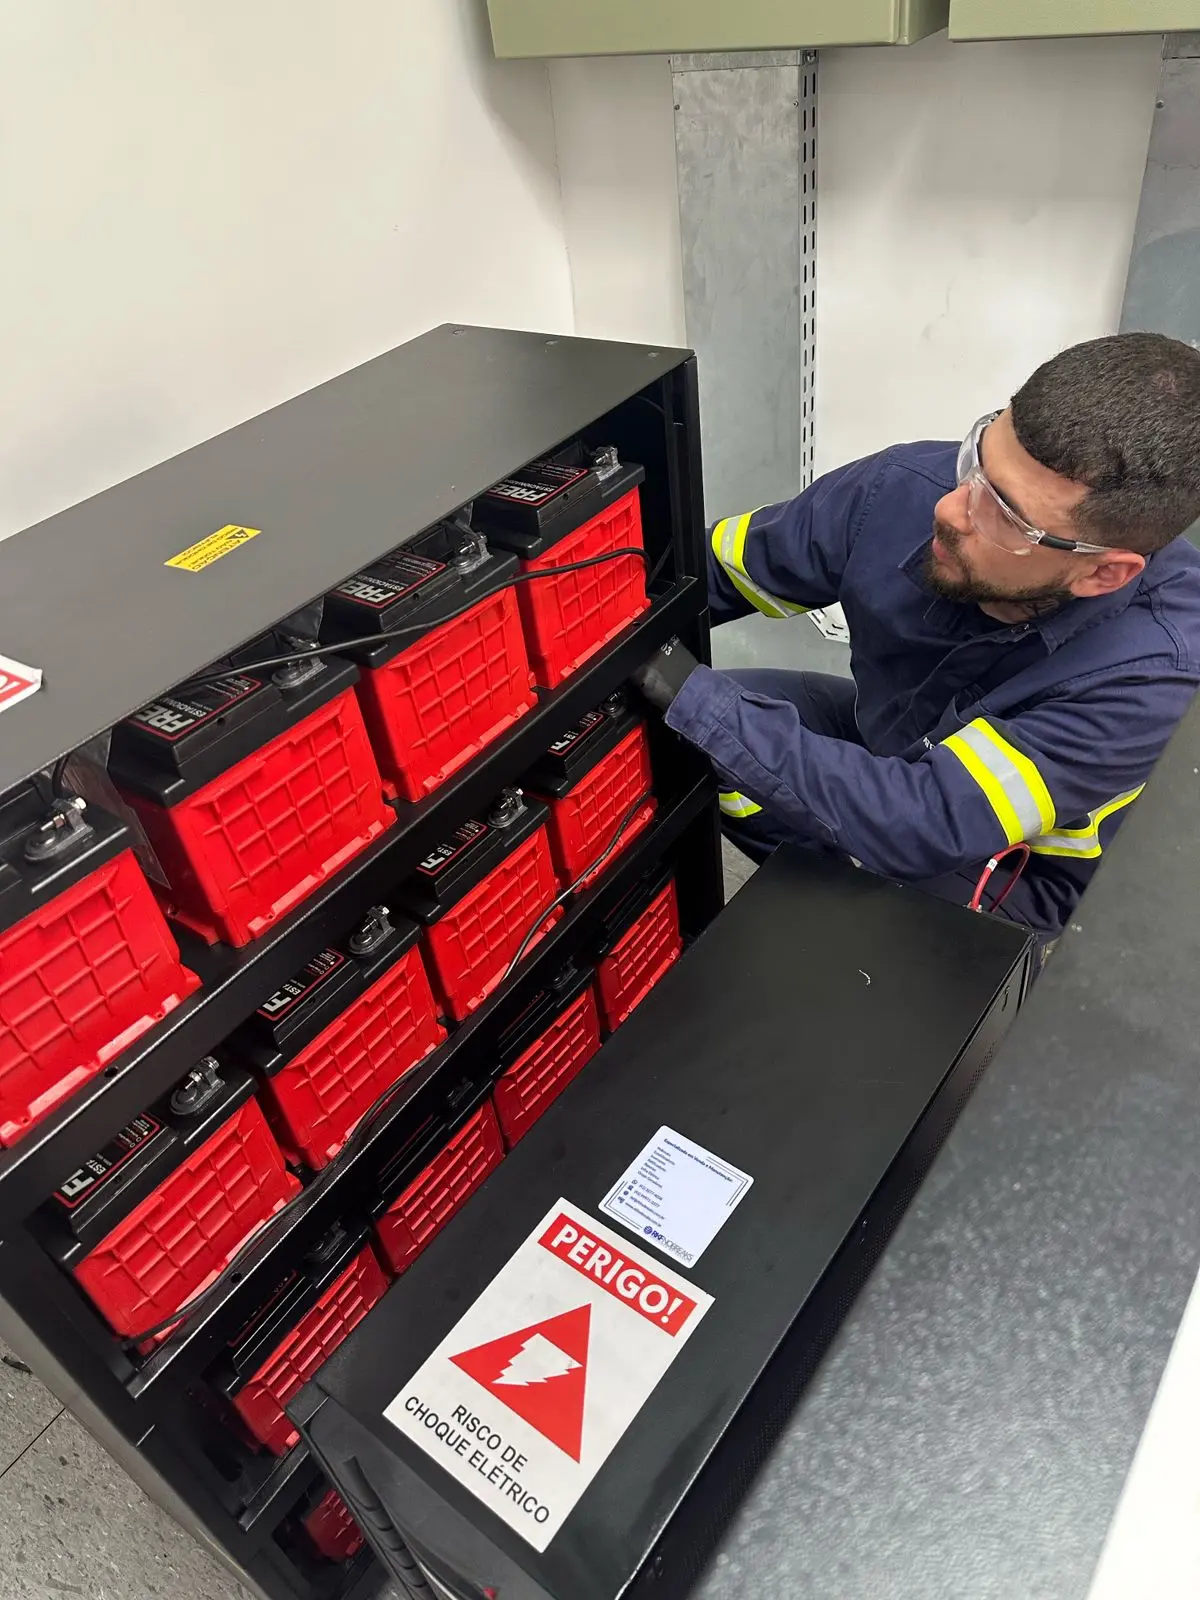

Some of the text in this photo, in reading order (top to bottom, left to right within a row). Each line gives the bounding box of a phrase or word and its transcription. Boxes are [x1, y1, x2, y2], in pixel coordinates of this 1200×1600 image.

[550, 1223, 684, 1323] PERIGO!
[404, 1395, 550, 1524] CHOQUE ELÉTRICO
[450, 1404, 528, 1473] RISCO DE
